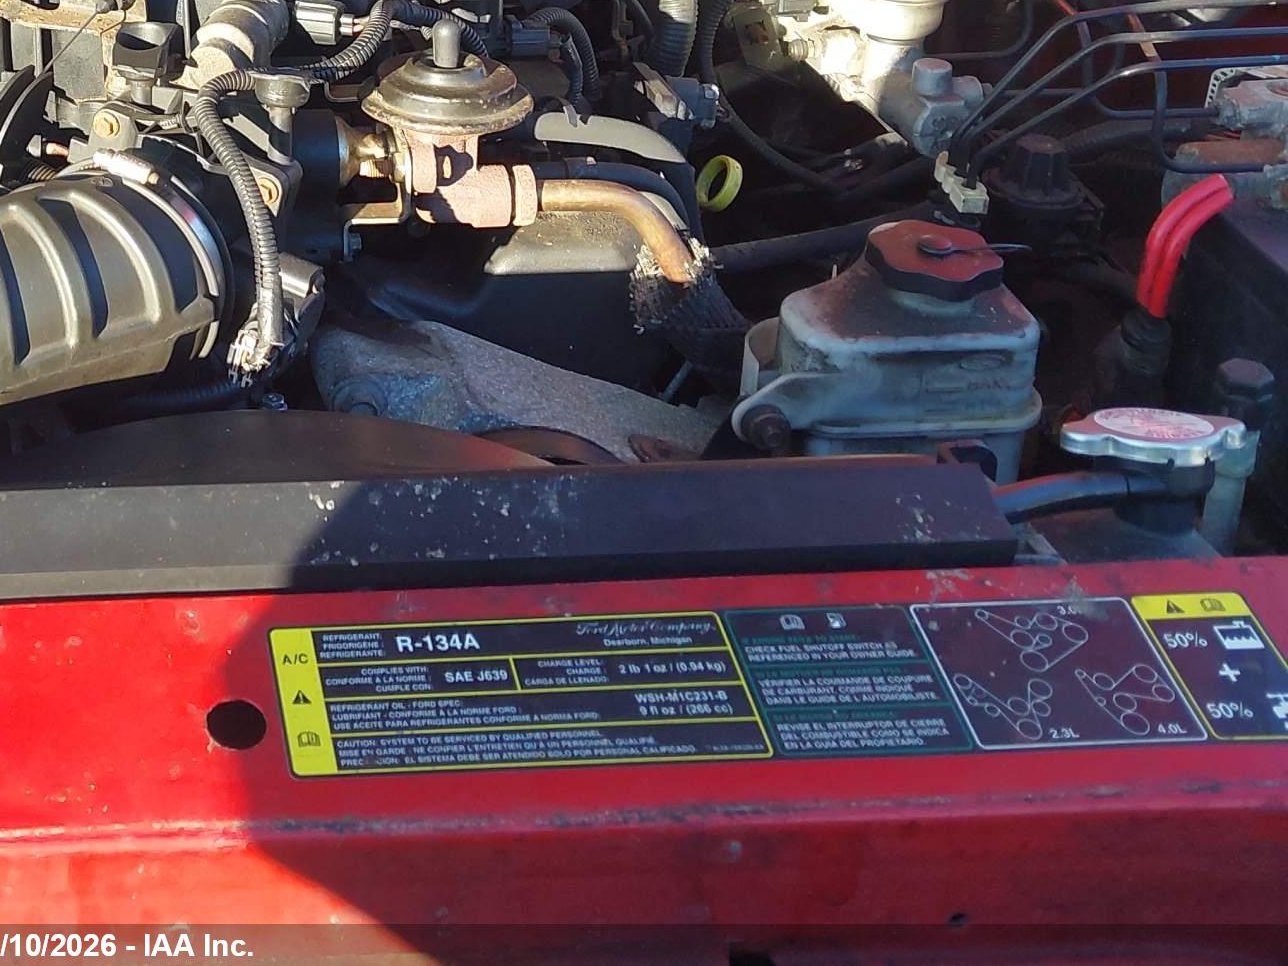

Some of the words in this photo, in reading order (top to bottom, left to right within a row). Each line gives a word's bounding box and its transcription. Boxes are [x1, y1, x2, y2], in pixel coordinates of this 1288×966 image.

[396, 633, 480, 652] R-134A
[604, 637, 649, 647] Dearborn,
[652, 636, 692, 647] Michigan
[1163, 632, 1209, 649] 50%
[745, 645, 777, 653] CHECK
[780, 644, 802, 652] FUEL
[805, 643, 845, 652] SHUTOFF
[847, 642, 883, 650] SWITCH
[282, 653, 309, 665] A/C
[748, 653, 809, 662] REFERENCED
[823, 651, 848, 660] YOUR
[850, 650, 884, 659] OWNER
[538, 659, 572, 668] CHARGE
[618, 665, 626, 674] 2
[628, 664, 641, 674] lb
[653, 665, 668, 673] oz
[707, 661, 727, 673] kg)
[361, 667, 404, 675] COMPLIES
[444, 671, 474, 683] SAE
[477, 669, 509, 682] J639
[566, 667, 602, 675] CHARGE
[325, 677, 373, 686] CONFORME
[383, 675, 394, 683] LA
[396, 674, 426, 682] NORME
[525, 677, 555, 686] CARGA
[557, 676, 567, 685] DE
[816, 676, 870, 686] COMMANDE
[872, 675, 884, 684] DE
[887, 674, 933, 683] COUPURE
[376, 685, 410, 693] CUMPLE
[763, 687, 776, 696] DE
[838, 685, 872, 693] COMME
[766, 696, 792, 705] DANS
[794, 695, 805, 704] LE
[807, 694, 836, 703] GUIDE
[839, 693, 852, 702] DE
[330, 703, 389, 713] REFRIGERANT
[392, 702, 406, 710] OIL
[413, 700, 436, 708] FORD
[661, 706, 675, 715] oz
[713, 703, 734, 715] cc)
[1206, 702, 1254, 719] 50%
[332, 712, 381, 722] LUBRIFIANT
[389, 710, 436, 719] CONFORME
[447, 708, 458, 716] LA
[460, 707, 491, 716] NORME
[493, 706, 517, 714] FORD
[334, 722, 351, 731] USE
[353, 721, 383, 730] ACEITE
[386, 720, 408, 728] PARA
[410, 717, 481, 727] REFRIGERANTES
[483, 714, 531, 724] CONFORME
[541, 712, 572, 721] NORMA
[777, 723, 811, 732] REVISE
[813, 722, 824, 731] EL
[827, 721, 893, 731] INTERRUPTOR
[895, 720, 908, 728] DE
[910, 718, 945, 728] CIERRE
[780, 732, 799, 741] DEL
[801, 730, 868, 740] COMBUSTIBLE
[870, 729, 899, 738] COMO
[901, 728, 914, 737] SE
[916, 727, 949, 736] INDICA
[1049, 728, 1081, 739] 2.3L
[1158, 722, 1188, 735] 4.0L
[380, 737, 415, 747] SYSTEM
[417, 737, 429, 745] TO
[431, 736, 442, 745] BE
[444, 735, 487, 744] SERVICED
[489, 734, 501, 742] BY
[503, 732, 548, 741] QUALIFIED
[784, 741, 798, 750] EN
[800, 741, 812, 749] LA
[840, 739, 859, 748] DEL
[338, 748, 359, 757] MISE
[376, 747, 406, 756] GARDE
[413, 746, 425, 754] NE
[427, 744, 466, 753] CONFIER
[547, 740, 560, 749] UN
[561, 738, 612, 748] PERSONNEL
[405, 756, 416, 764] EL
[418, 754, 454, 763] SISTEMA
[457, 753, 479, 762] DEBE
[482, 752, 501, 760] SER
[503, 751, 546, 760] ATENDIDO
[573, 748, 592, 757] POR
[594, 747, 641, 756] PERSONAL
